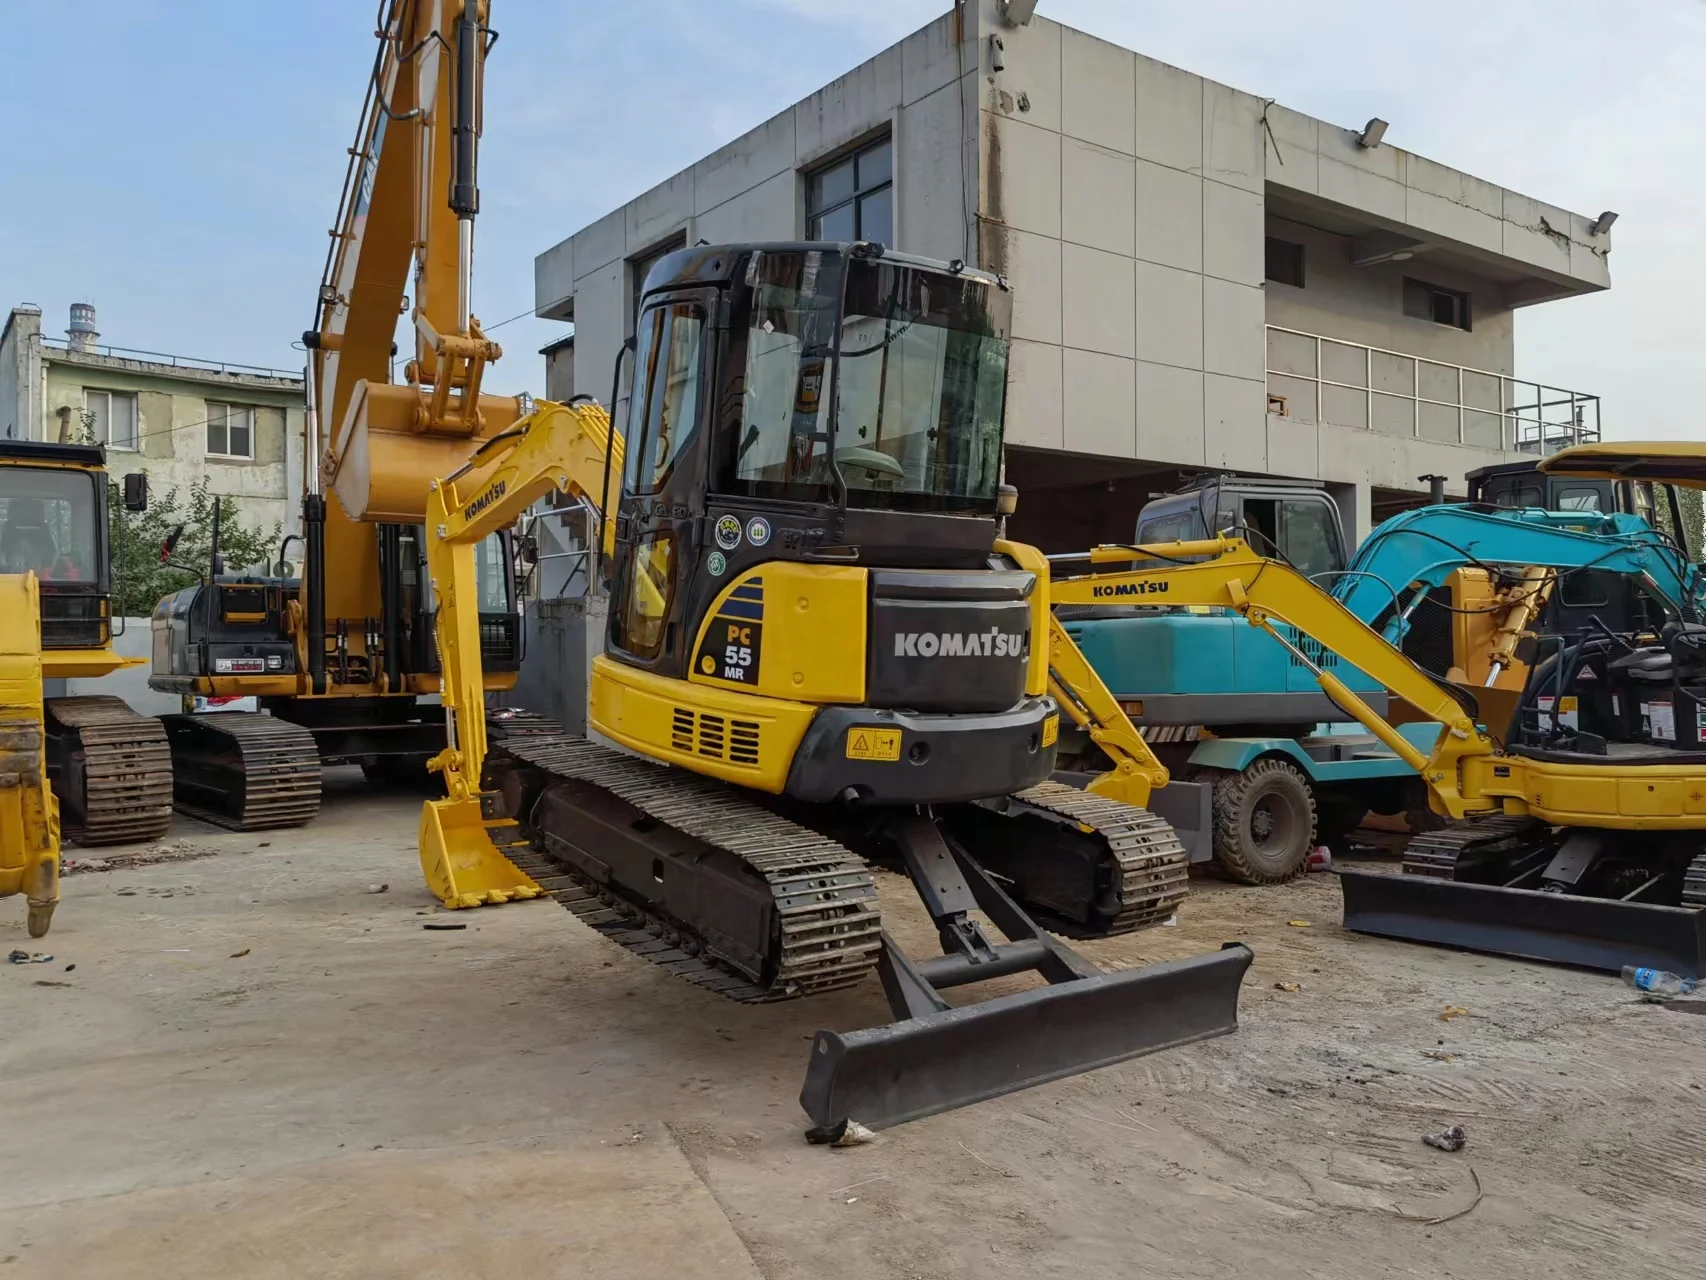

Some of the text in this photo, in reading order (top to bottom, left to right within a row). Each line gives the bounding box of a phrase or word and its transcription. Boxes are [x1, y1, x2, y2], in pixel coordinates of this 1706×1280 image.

[465, 480, 505, 521] KOMATSU
[1093, 580, 1169, 597] KOMATSU
[728, 625, 750, 645] PC
[895, 626, 1021, 657] KOMATSU
[725, 646, 751, 666] 55
[725, 667, 744, 680] MR
